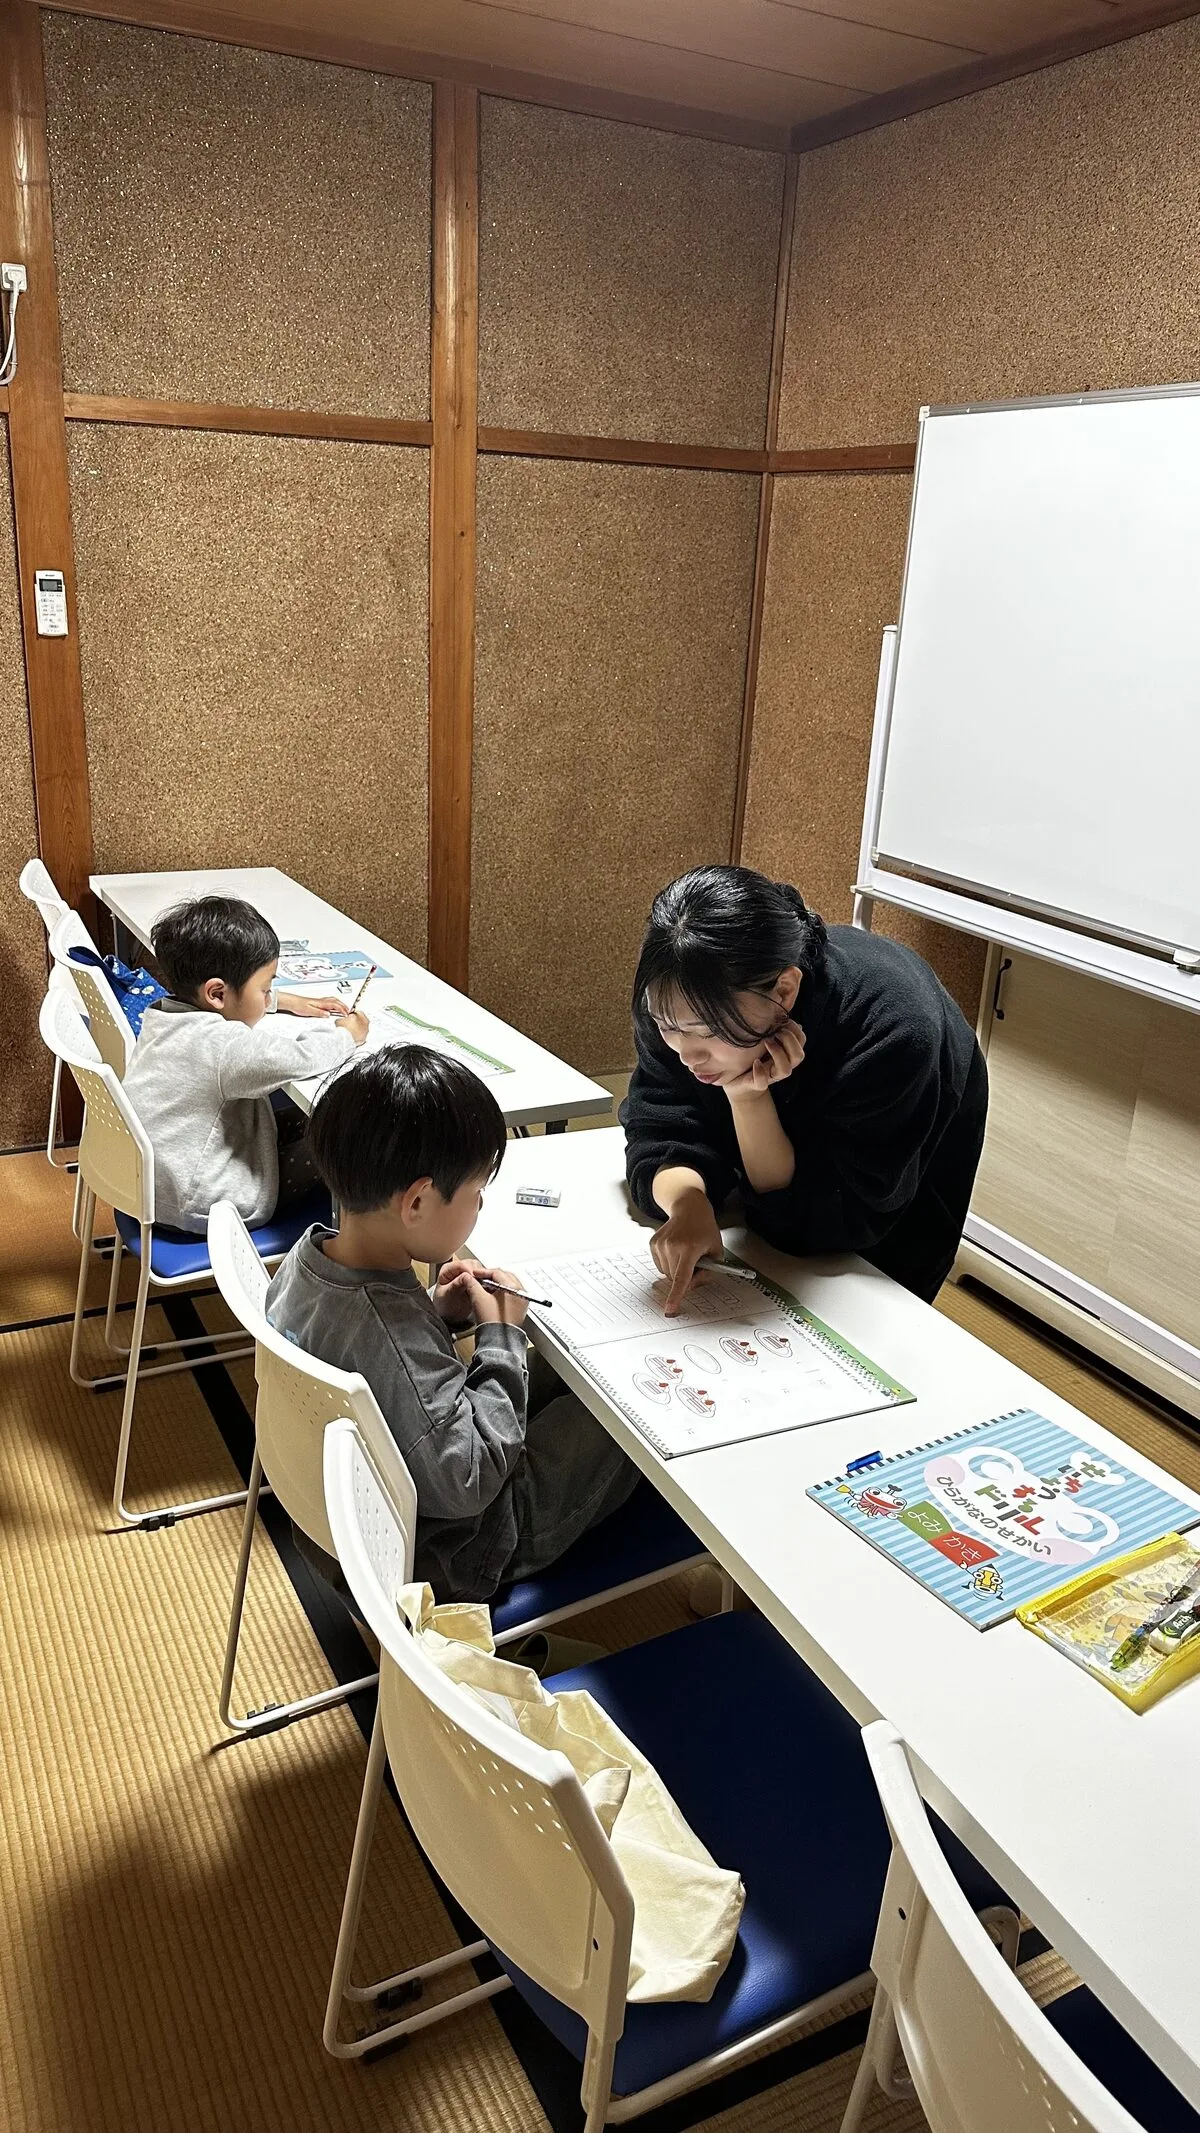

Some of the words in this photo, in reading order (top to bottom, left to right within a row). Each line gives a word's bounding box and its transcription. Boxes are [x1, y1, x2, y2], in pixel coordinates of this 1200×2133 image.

[907, 1511, 943, 1533] よみ
[936, 1476, 1052, 1555] ひらがなのせかい
[974, 1484, 1045, 1536] ドリル
[943, 1536, 982, 1562] かき
[1172, 1614, 1192, 1629] Arch
